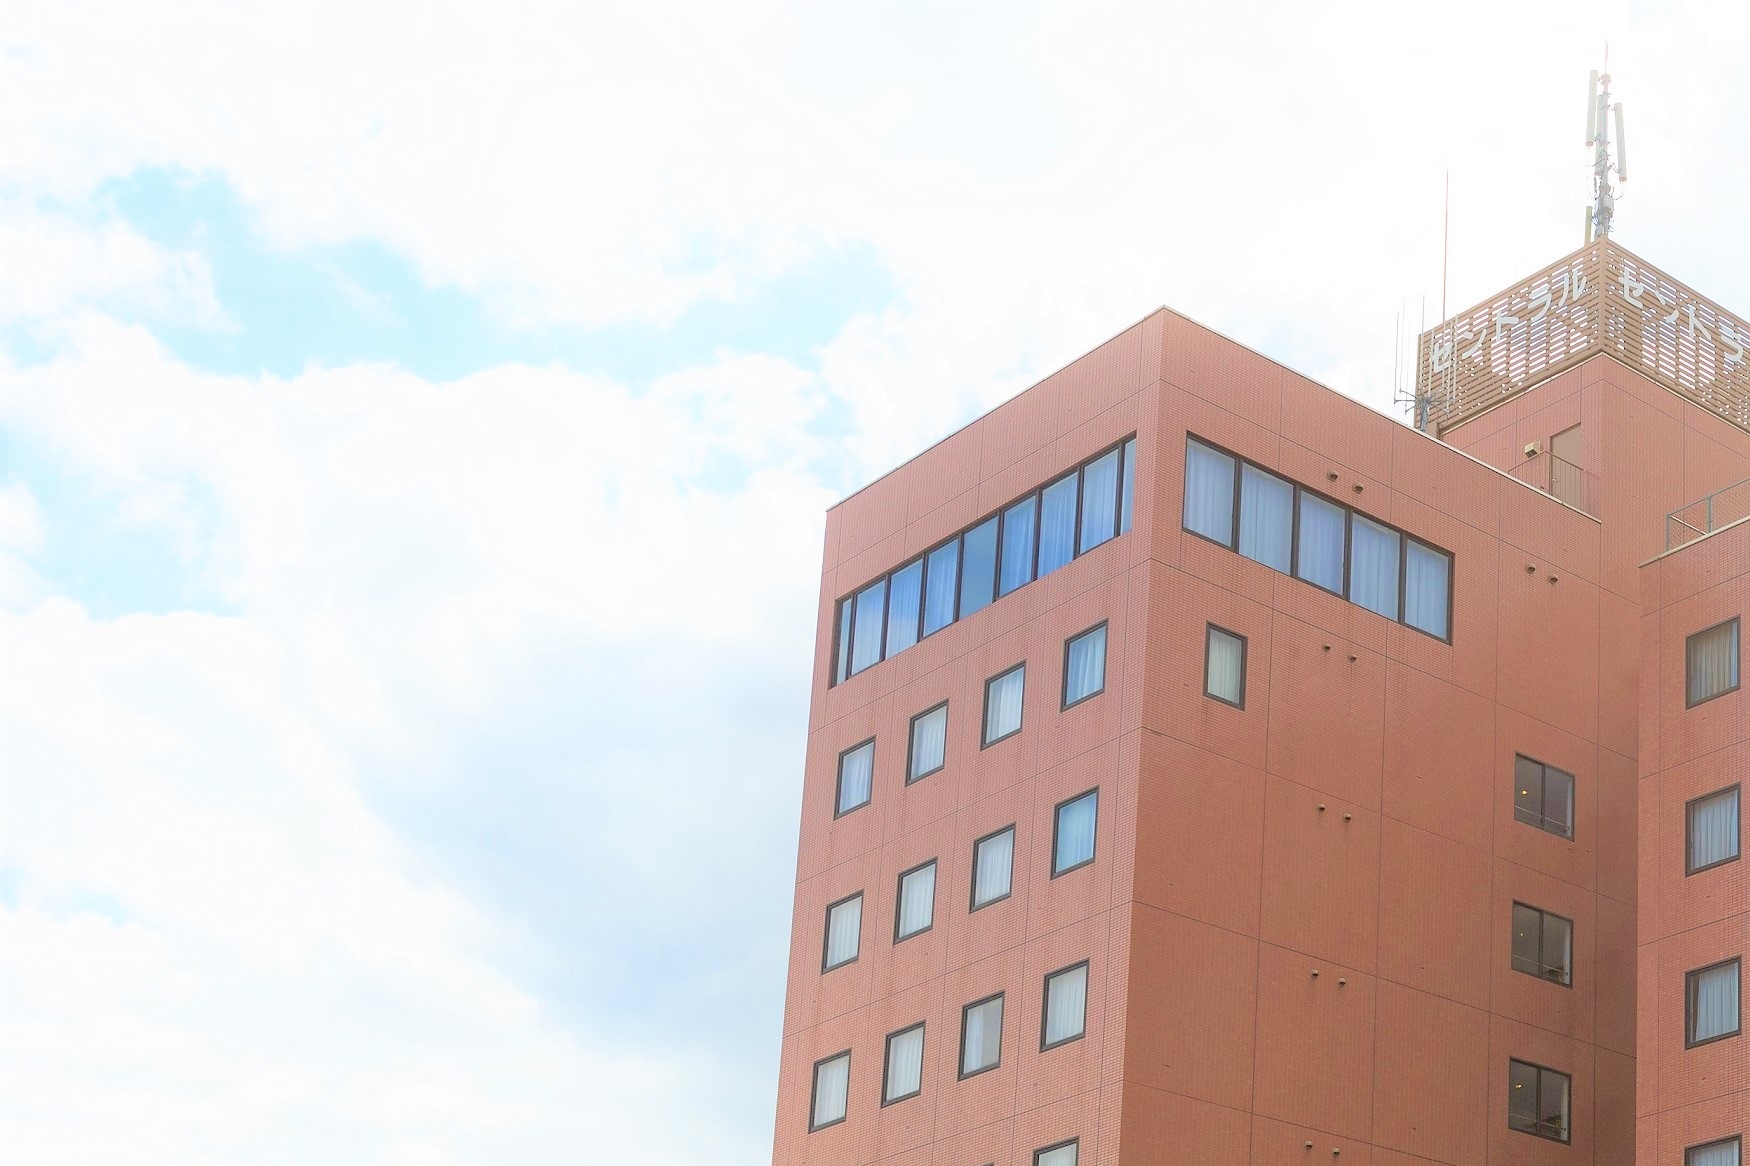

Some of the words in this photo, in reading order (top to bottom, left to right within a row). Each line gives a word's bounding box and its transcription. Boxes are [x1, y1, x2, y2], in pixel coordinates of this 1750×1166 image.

[1431, 268, 1588, 373] セントラル
